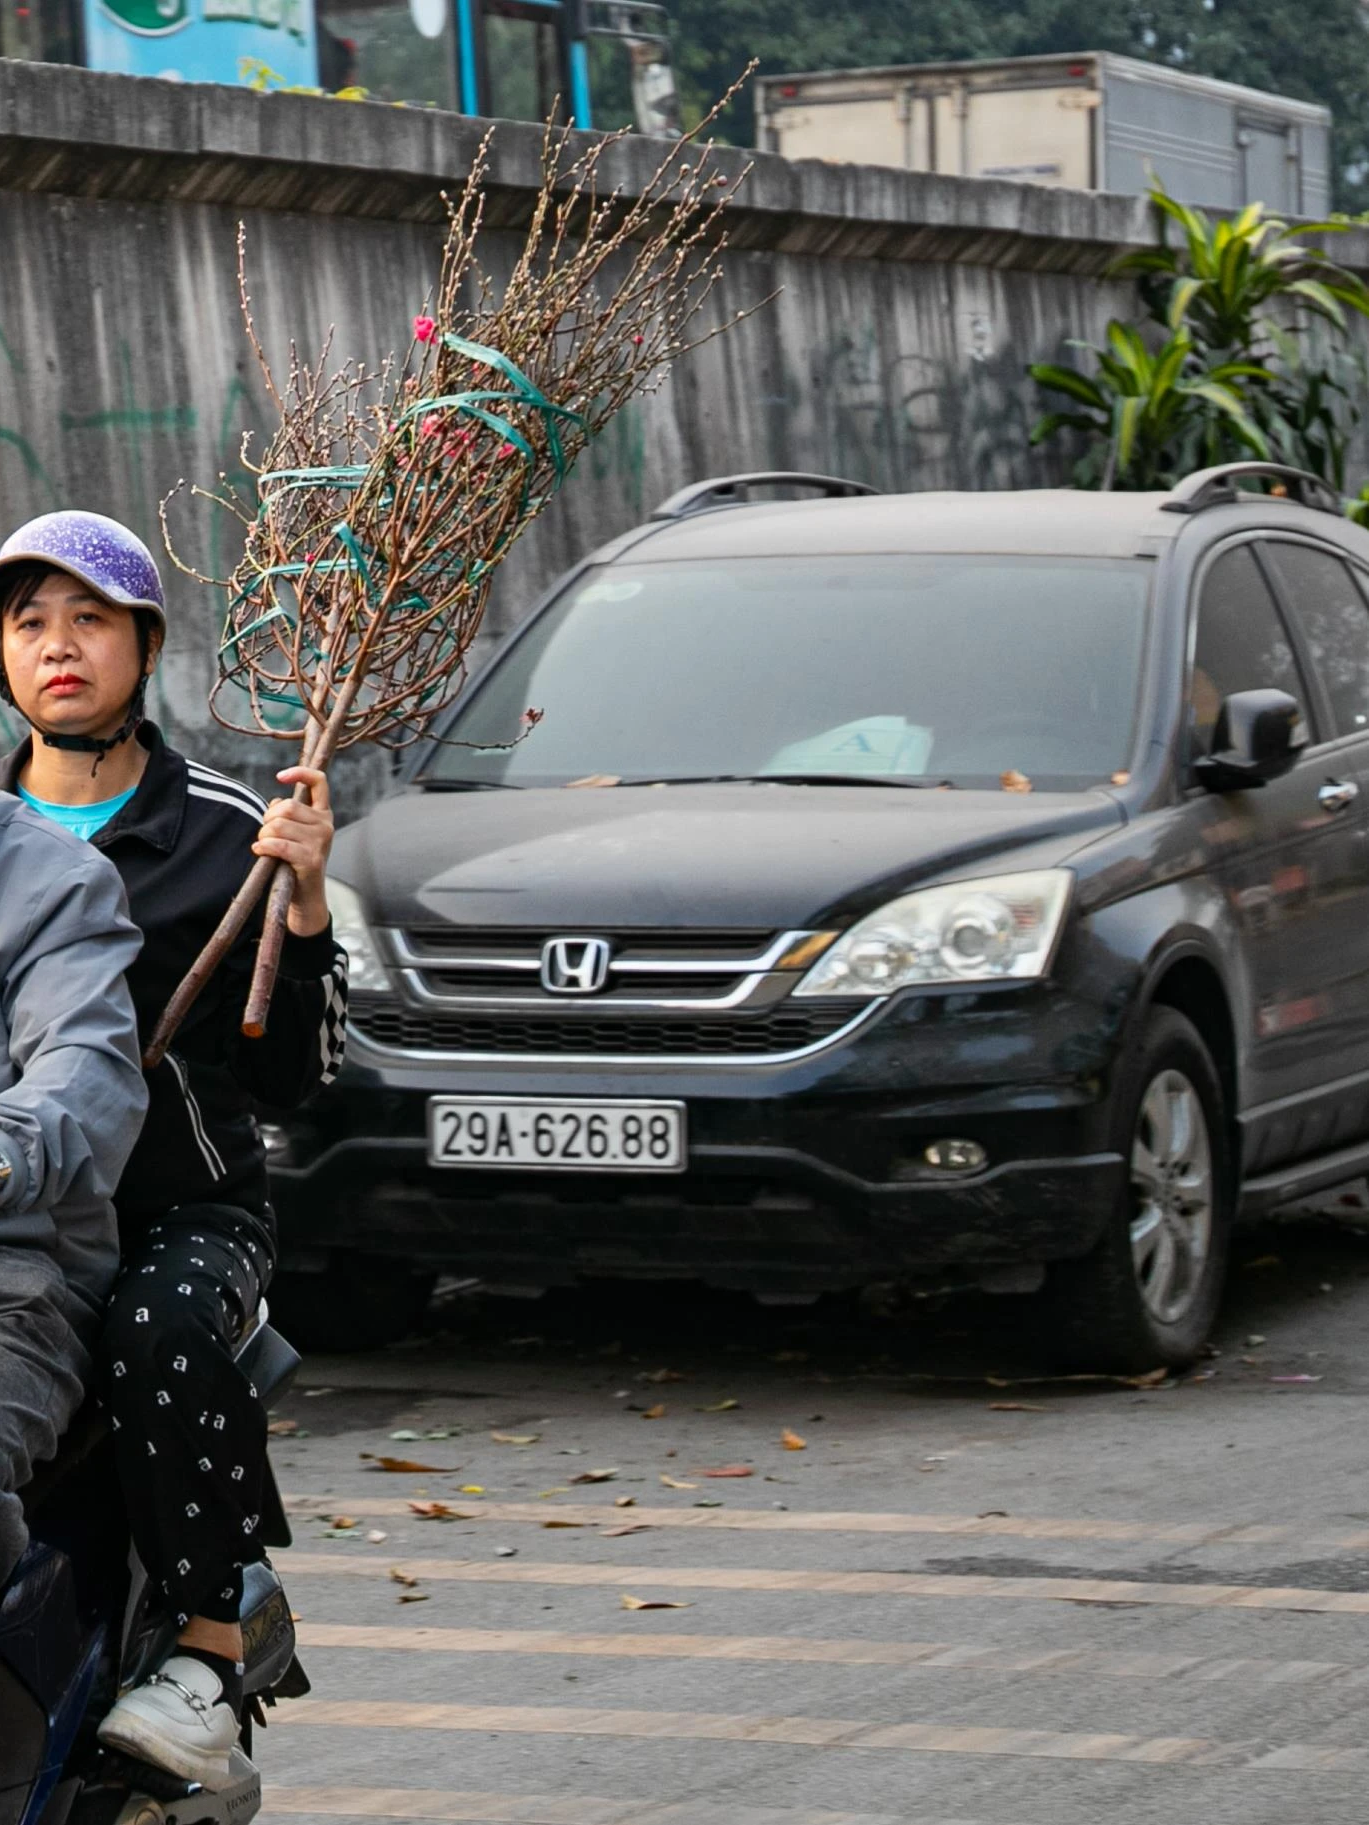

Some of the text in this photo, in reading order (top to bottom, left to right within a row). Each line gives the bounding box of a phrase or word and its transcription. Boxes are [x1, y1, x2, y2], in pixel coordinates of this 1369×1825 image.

[441, 1111, 671, 1160] 29A-626.88
[135, 1307, 149, 1322] a
[113, 1361, 127, 1377] a
[173, 1355, 188, 1373] a
[156, 1390, 172, 1405] a
[213, 1414, 226, 1431] a
[198, 1457, 212, 1471] a
[231, 1465, 244, 1481] a
[185, 1502, 200, 1518] a
